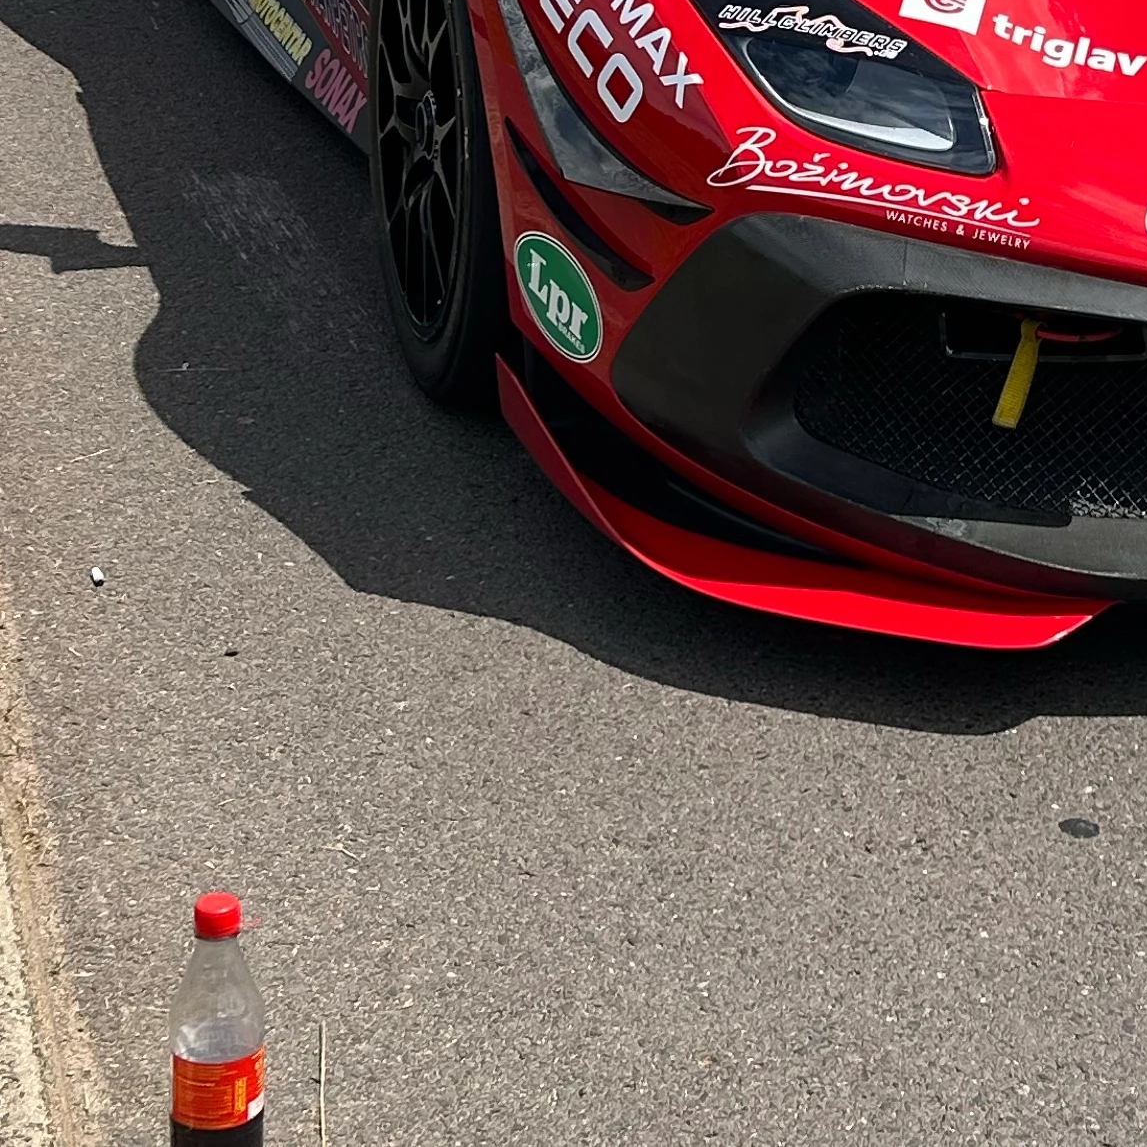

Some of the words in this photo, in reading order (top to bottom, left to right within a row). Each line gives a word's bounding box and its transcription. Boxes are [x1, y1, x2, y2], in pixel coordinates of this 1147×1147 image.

[718, 4, 908, 55] HILLCLIMBERS
[305, 49, 368, 134] SONAX
[885, 209, 949, 233] WATCHES
[955, 224, 966, 237] &
[971, 227, 1032, 251] JEWELRY
[528, 248, 589, 340] Lpr
